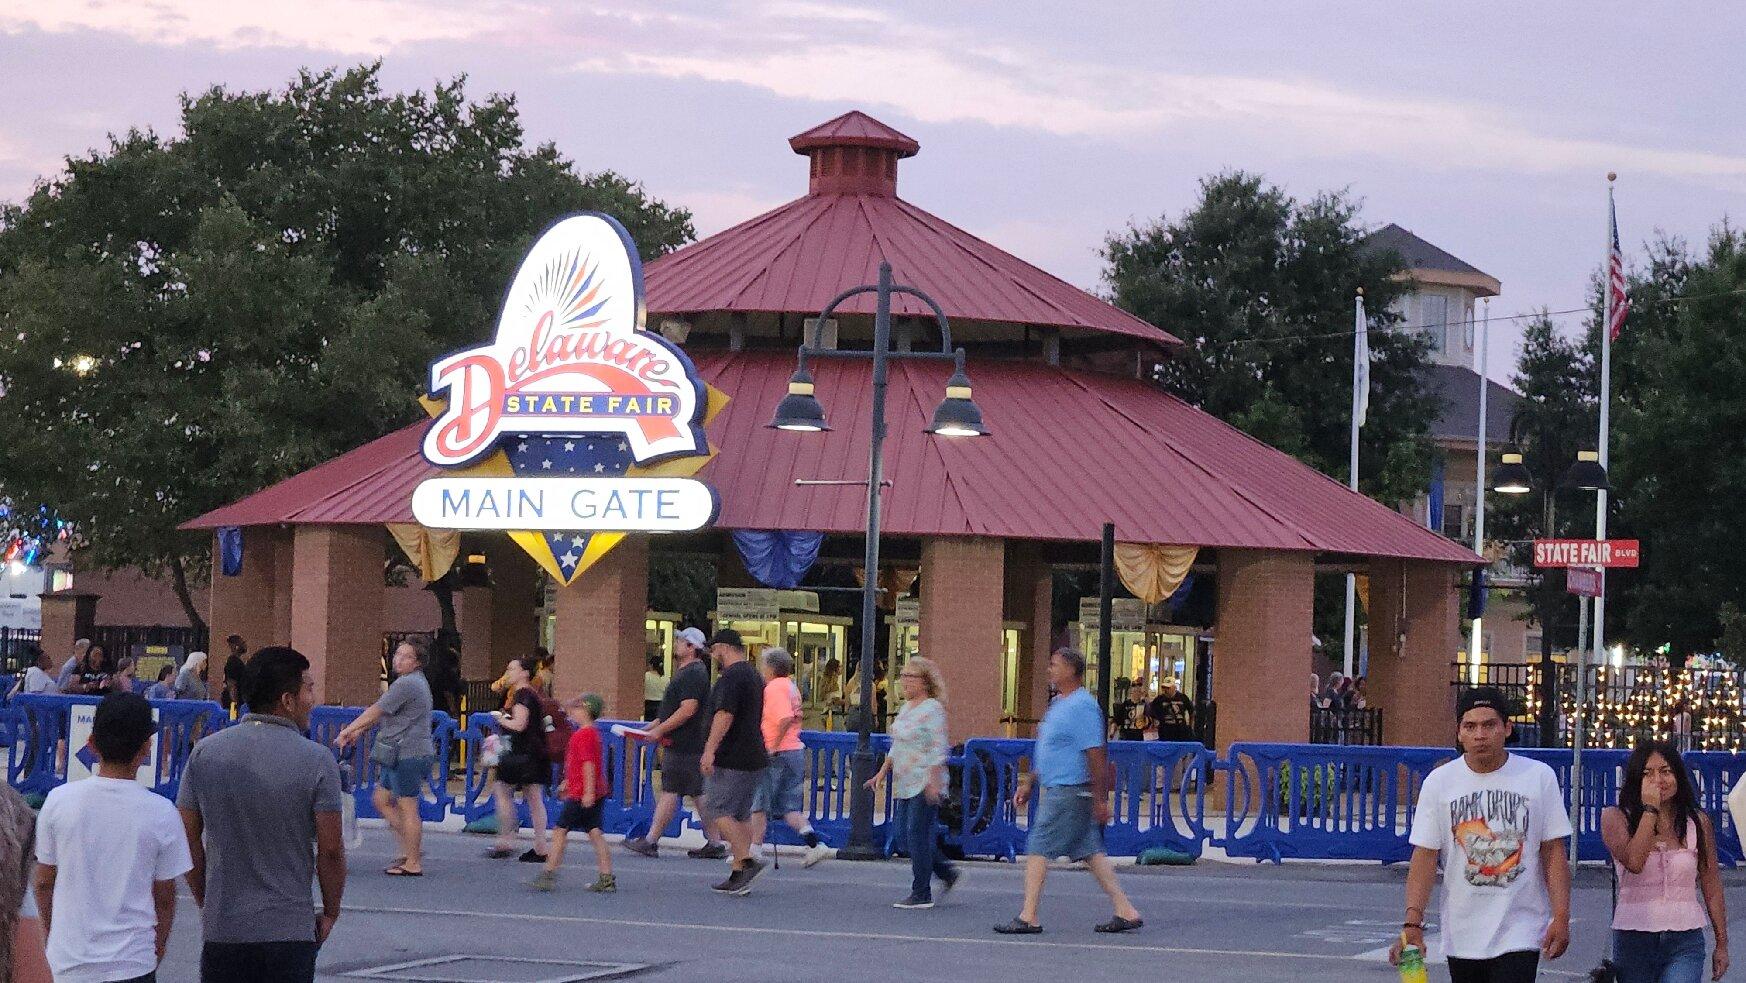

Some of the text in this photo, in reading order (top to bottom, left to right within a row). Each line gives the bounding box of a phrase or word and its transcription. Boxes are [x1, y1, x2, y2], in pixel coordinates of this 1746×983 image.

[437, 310, 681, 457] Delaware
[507, 396, 672, 414] STATE FAIR
[442, 489, 680, 519] MAIN GATE
[1536, 542, 1637, 563] STATE FAIR BLVD
